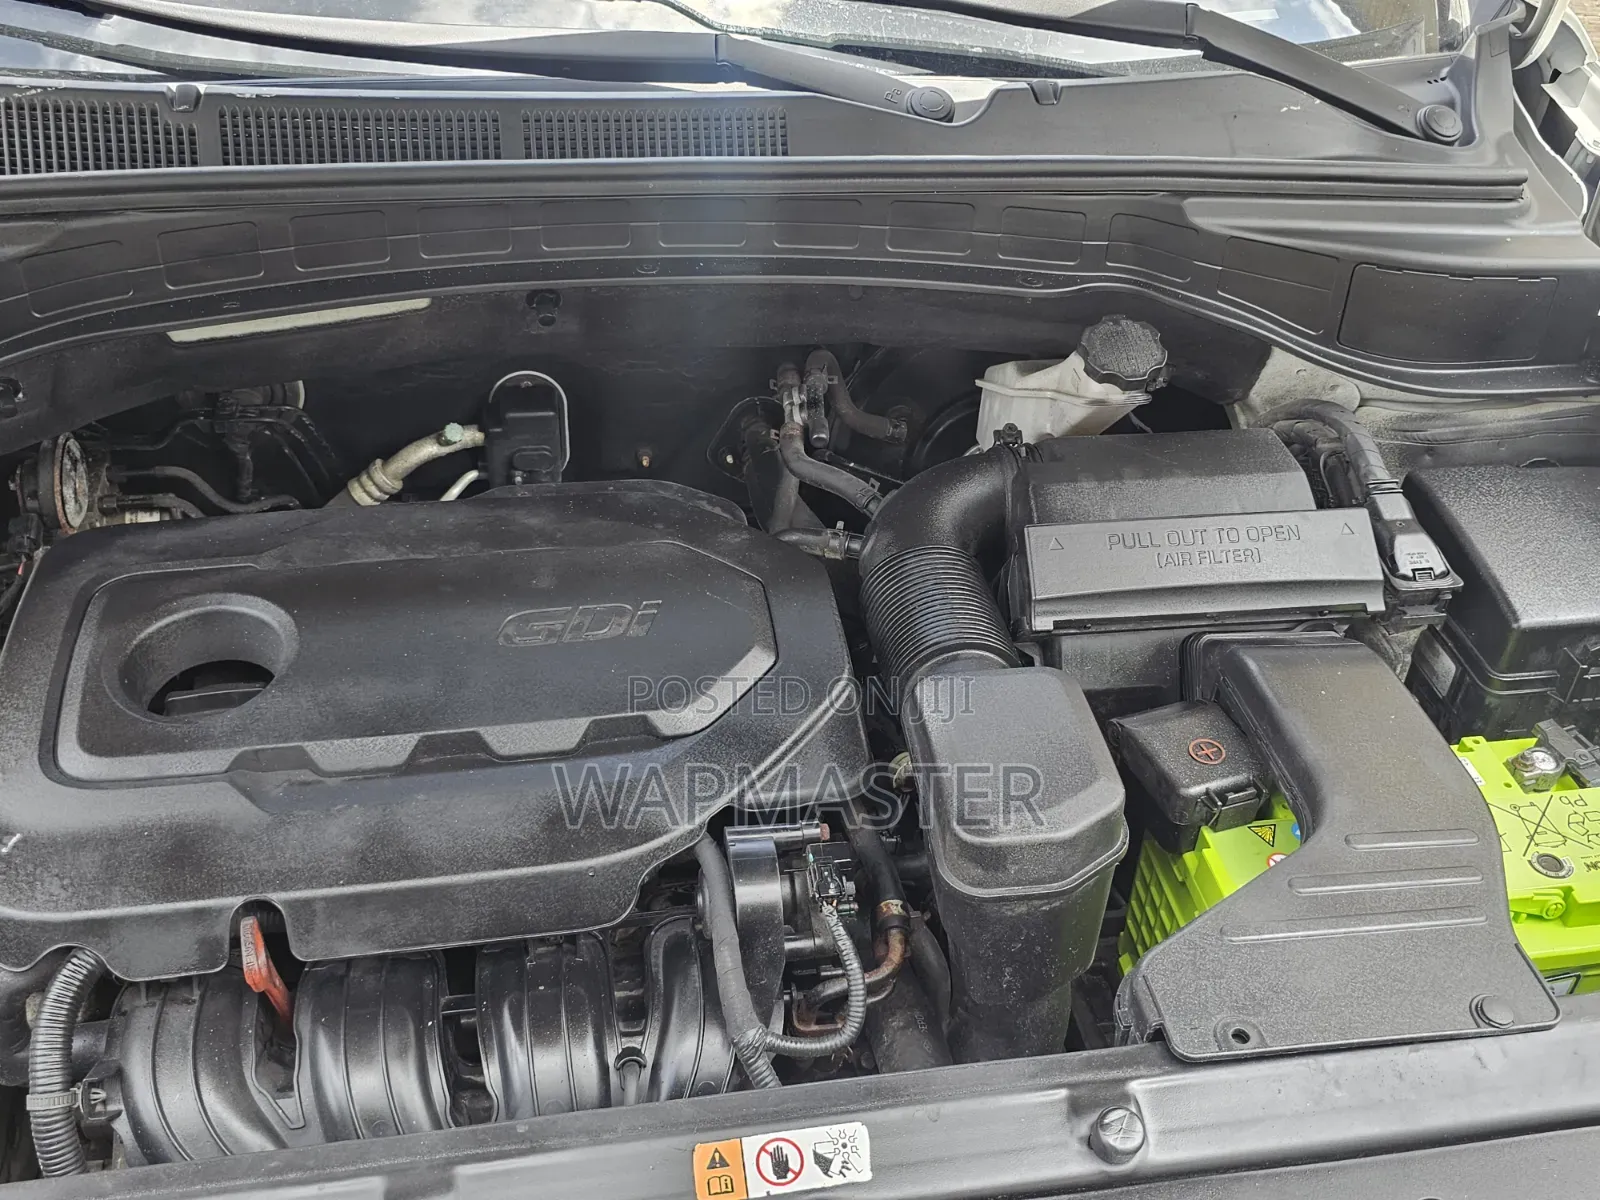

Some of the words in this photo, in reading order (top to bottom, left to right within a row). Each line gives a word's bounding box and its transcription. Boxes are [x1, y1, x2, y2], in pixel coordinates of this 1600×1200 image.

[1107, 531, 1161, 550] PULL
[1166, 529, 1207, 547] OUT
[1216, 527, 1240, 544] TO
[1246, 525, 1301, 543] OPEN
